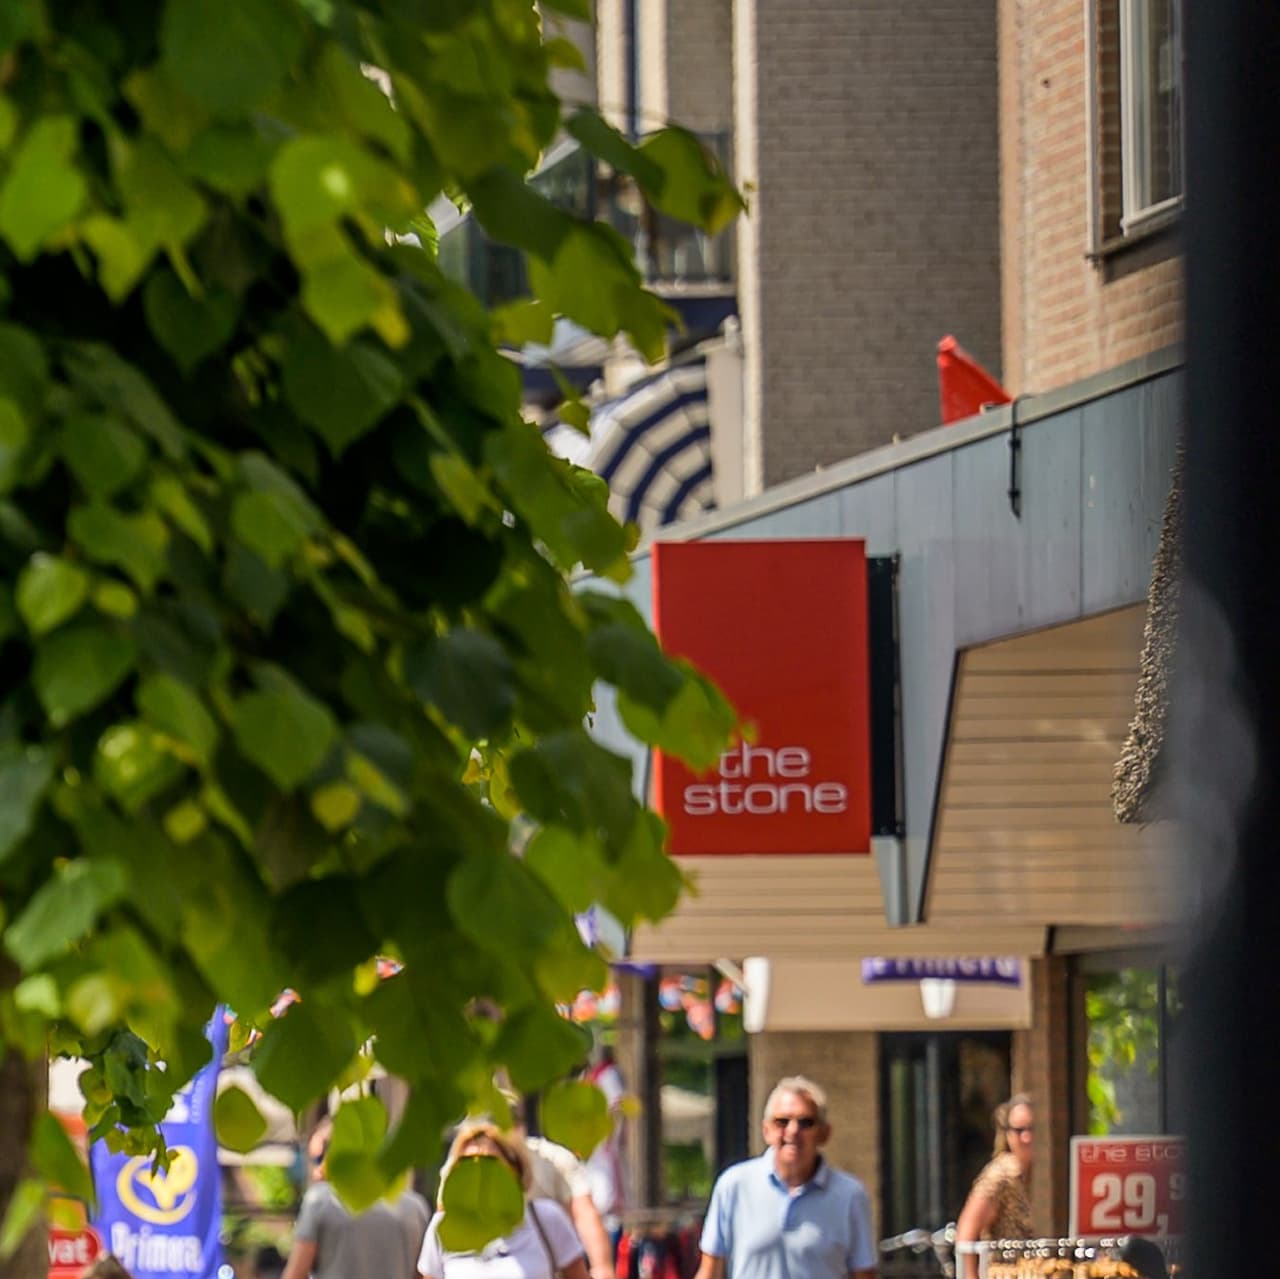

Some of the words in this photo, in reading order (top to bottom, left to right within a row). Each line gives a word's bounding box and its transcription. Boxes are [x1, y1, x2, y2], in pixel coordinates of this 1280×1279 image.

[719, 741, 811, 779] the
[683, 778, 848, 815] stone
[1135, 1143, 1182, 1162] sto
[47, 1234, 88, 1264] vat
